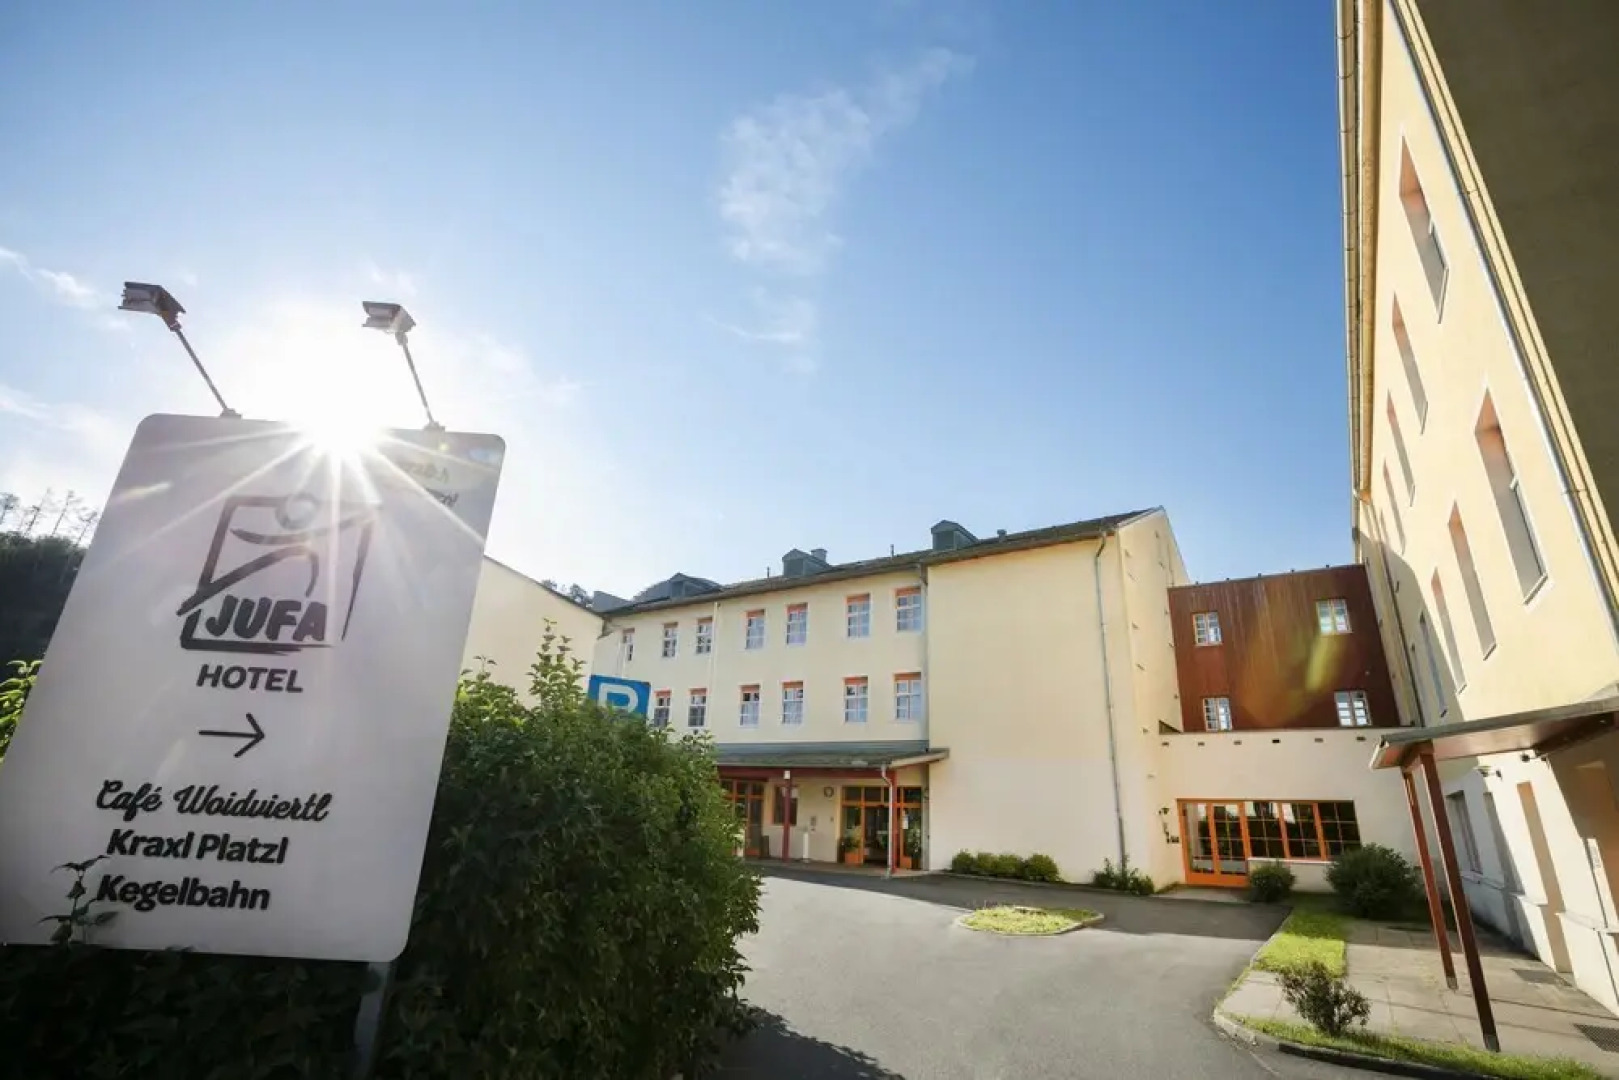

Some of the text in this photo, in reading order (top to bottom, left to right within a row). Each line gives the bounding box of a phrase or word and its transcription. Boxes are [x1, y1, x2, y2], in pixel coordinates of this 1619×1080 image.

[205, 594, 327, 641] JUFA
[196, 664, 303, 693] HOTEL
[97, 779, 332, 821] Café Woidviertl
[107, 829, 289, 863] Kraxl Platzl
[97, 874, 271, 911] Kegelbahn
